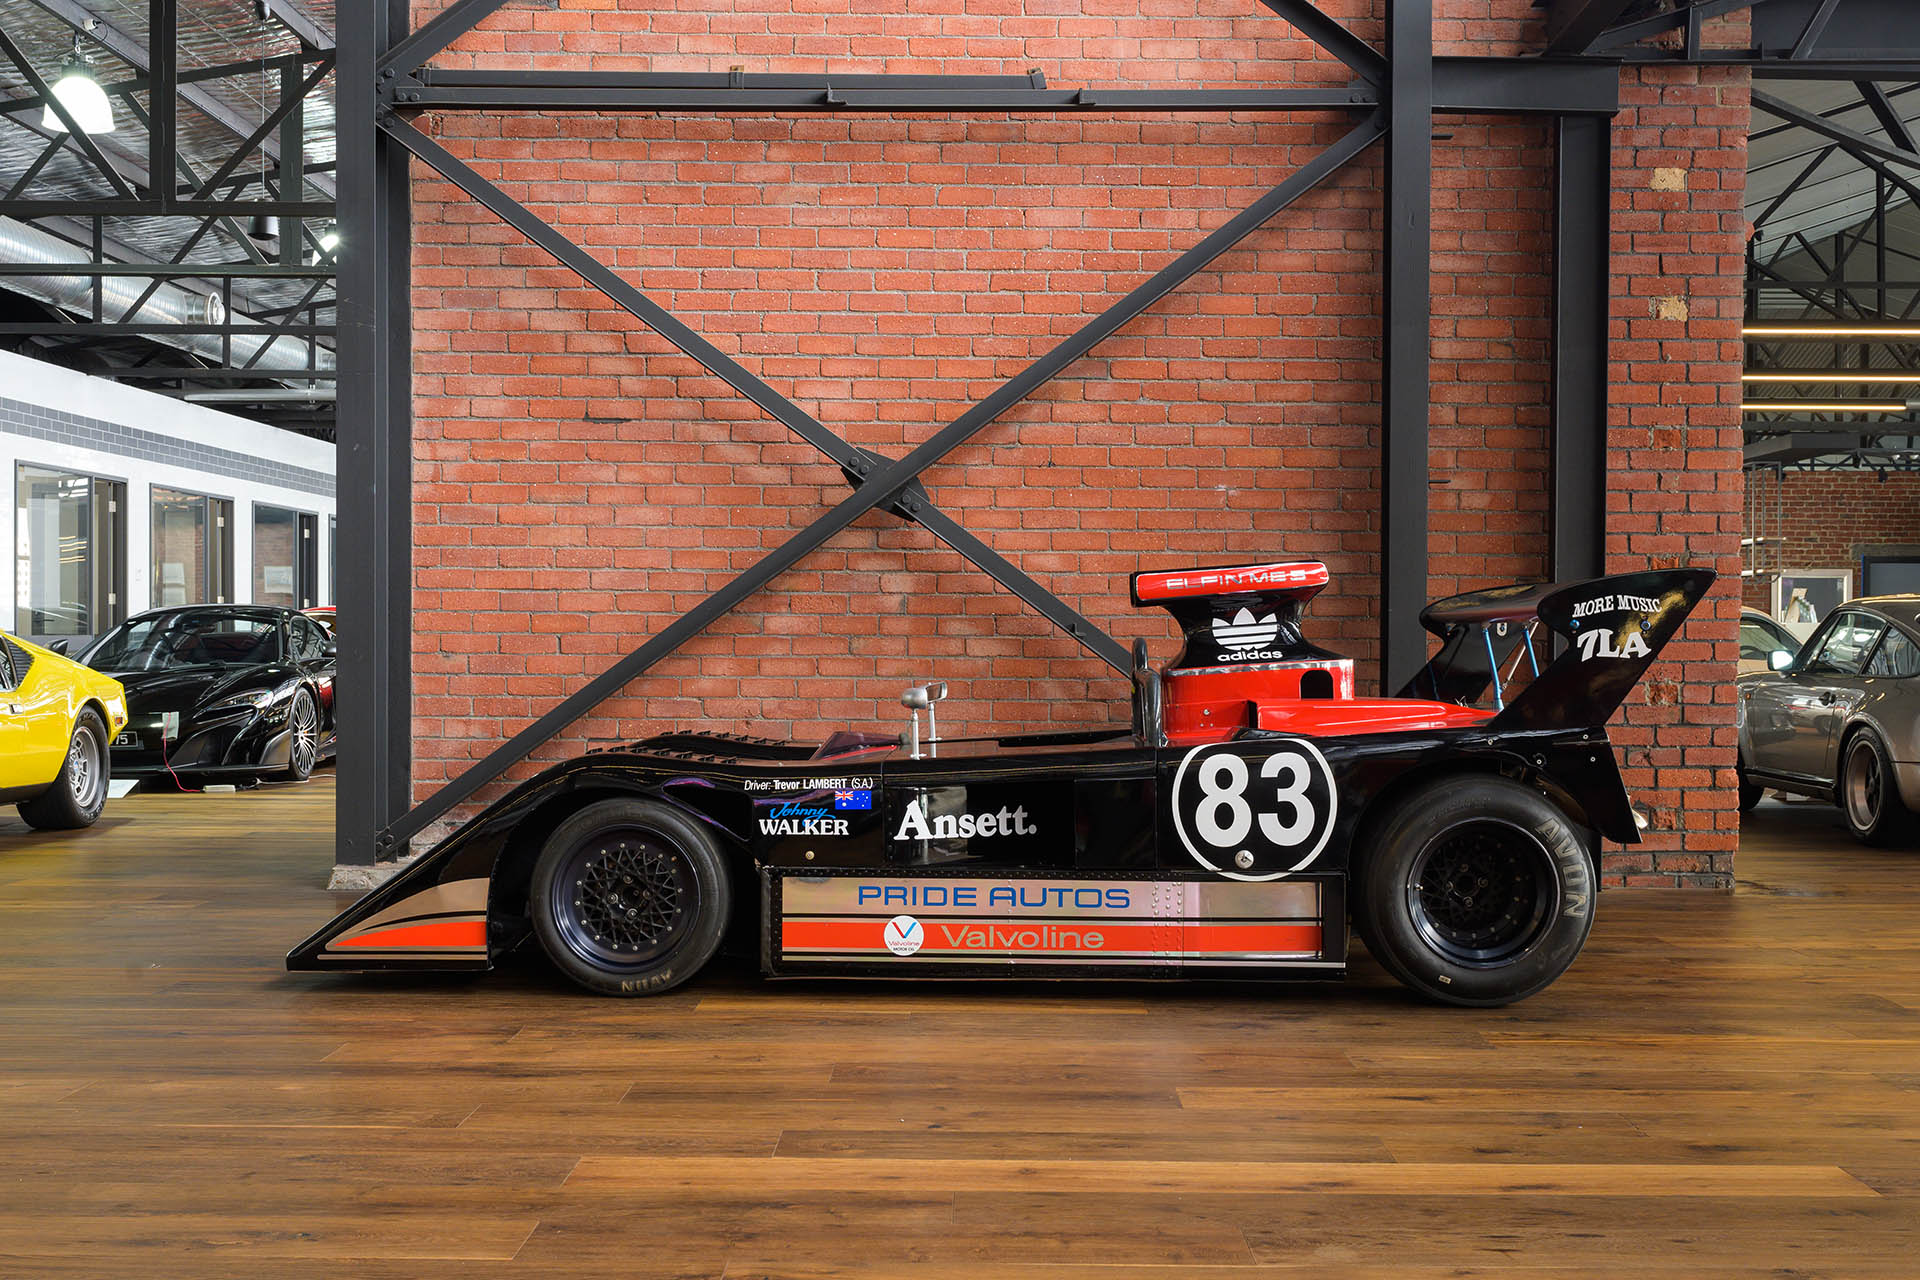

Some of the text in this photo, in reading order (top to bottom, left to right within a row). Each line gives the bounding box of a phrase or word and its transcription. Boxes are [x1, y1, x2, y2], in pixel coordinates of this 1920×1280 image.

[1166, 574, 1243, 590] ELFIN
[1572, 594, 1662, 618] MORE MUSIC
[1217, 649, 1283, 662] adidas
[1577, 628, 1652, 662] 7LA
[744, 780, 772, 791] Driver:
[773, 779, 800, 790] Trevor
[802, 778, 847, 789] LAMBERT
[1195, 752, 1316, 848] 83
[758, 818, 849, 835] WALKER
[769, 802, 836, 827] Johnny
[893, 800, 1037, 841] Ansett.
[1535, 817, 1587, 918] AVON
[858, 885, 1130, 909] PRIDE AUTOS
[941, 925, 1105, 949] Valvoline
